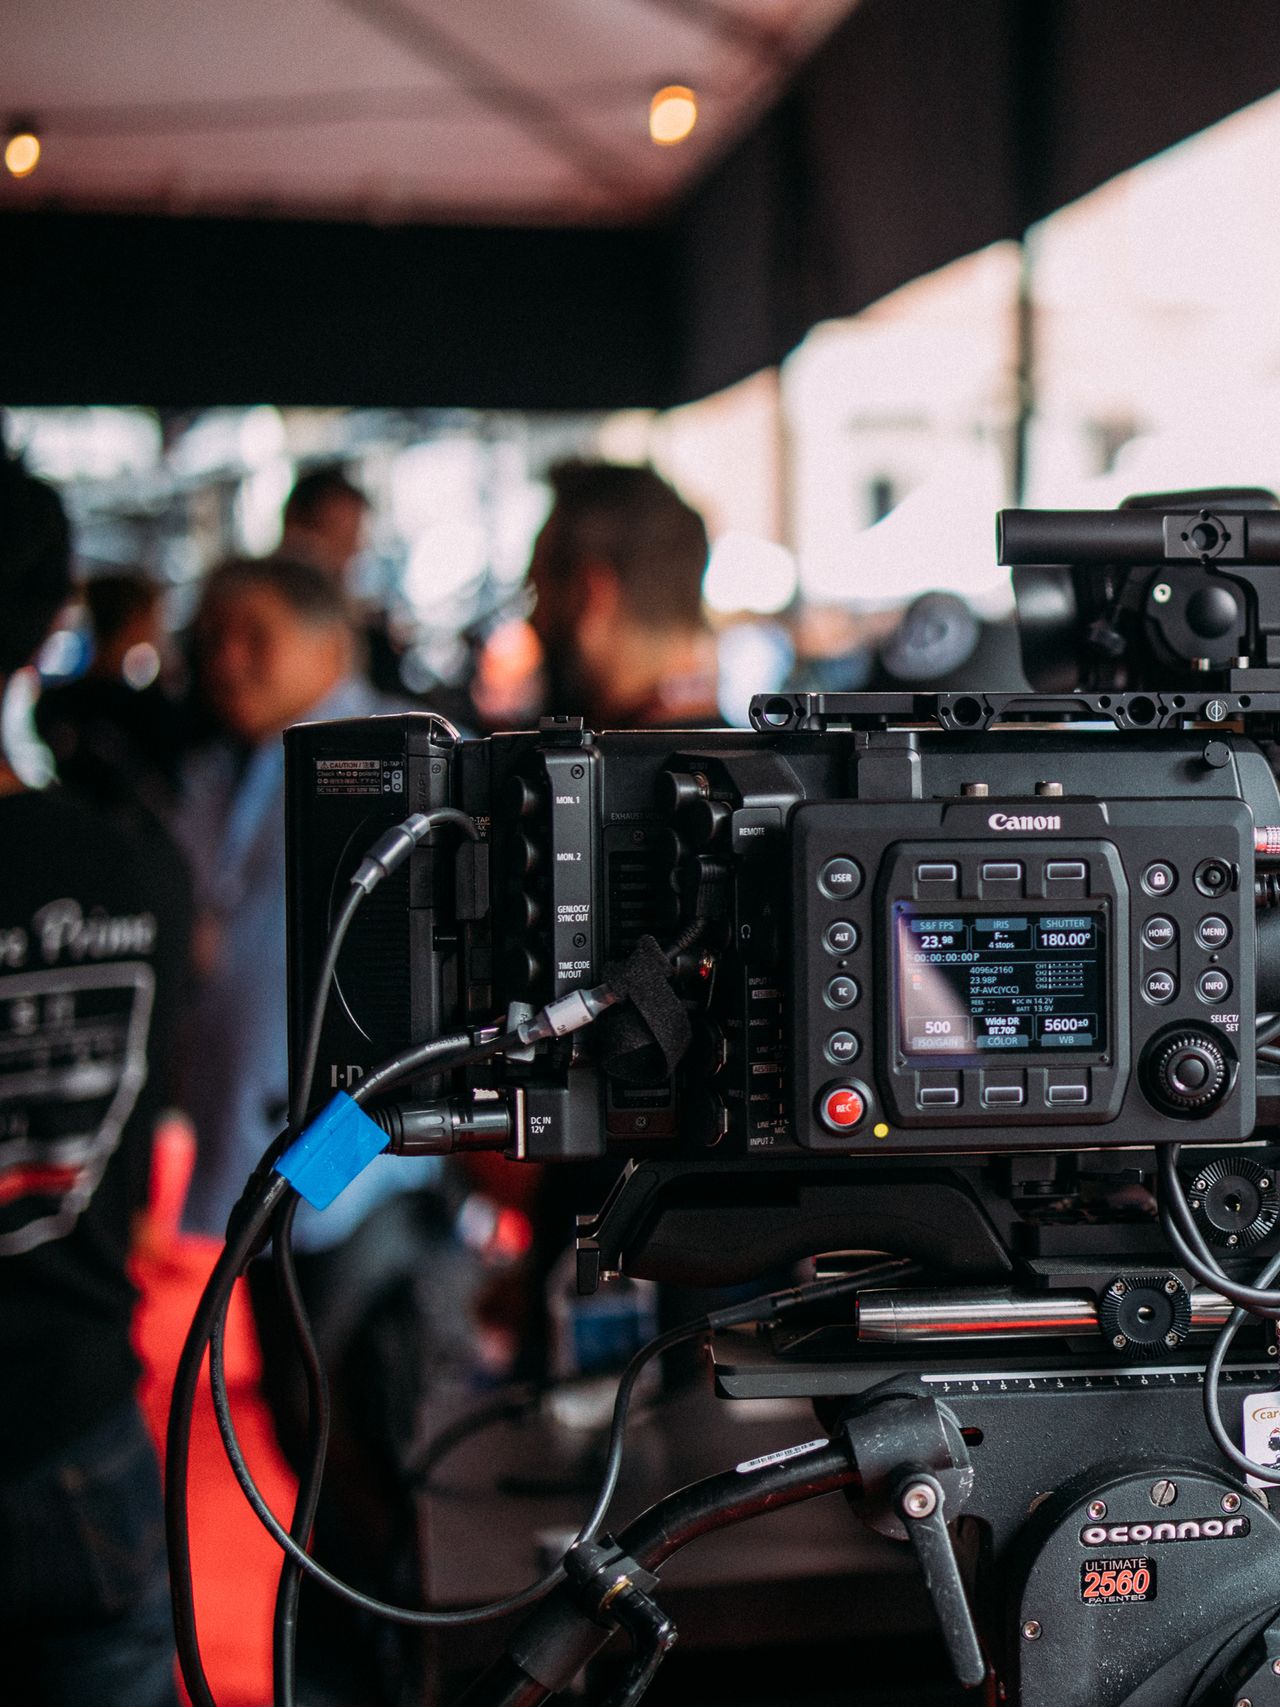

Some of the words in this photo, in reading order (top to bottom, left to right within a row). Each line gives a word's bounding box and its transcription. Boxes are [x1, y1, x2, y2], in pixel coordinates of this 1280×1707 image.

[988, 813, 1061, 831] Canon
[739, 827, 765, 836] REMOTE
[831, 873, 852, 883] USER
[557, 905, 590, 913] GENLOCK/
[557, 914, 574, 922] SYNC
[575, 914, 588, 922] OUT
[919, 921, 938, 930] S&F
[939, 921, 954, 930] FPS
[993, 920, 1010, 929] IRIS
[1046, 918, 1085, 928] SHUTTER
[1148, 928, 1171, 938] HOME
[1202, 928, 1225, 937] MENU
[835, 933, 849, 942] ALT
[995, 941, 1014, 949] stops
[558, 962, 573, 970] TIME
[573, 961, 590, 969] CODE
[558, 970, 582, 979] IN/OUT
[969, 966, 1014, 975] 4096x2160
[1149, 982, 1170, 991] BACK
[1205, 982, 1224, 990] INFO
[837, 987, 848, 996] TC
[985, 1017, 1006, 1025] Wide
[1007, 1017, 1020, 1025] DR
[1210, 1014, 1239, 1023] SELECT/
[925, 1021, 951, 1034] 500
[988, 1026, 1016, 1035] BT.709
[1225, 1023, 1239, 1032] SET
[987, 1037, 1018, 1046] COLOR
[1059, 1035, 1074, 1044] WB
[834, 1042, 853, 1051] PLAY
[835, 1104, 852, 1113] REC
[530, 1116, 541, 1125] DC
[542, 1116, 552, 1125] IN
[531, 1125, 545, 1134] 12V
[750, 1137, 768, 1146] INPUT
[1082, 1518, 1243, 1544] oconnor
[1085, 1558, 1148, 1572] ULTIMATE
[1083, 1568, 1150, 1598] 2560
[1088, 1594, 1147, 1604] PATENTED
